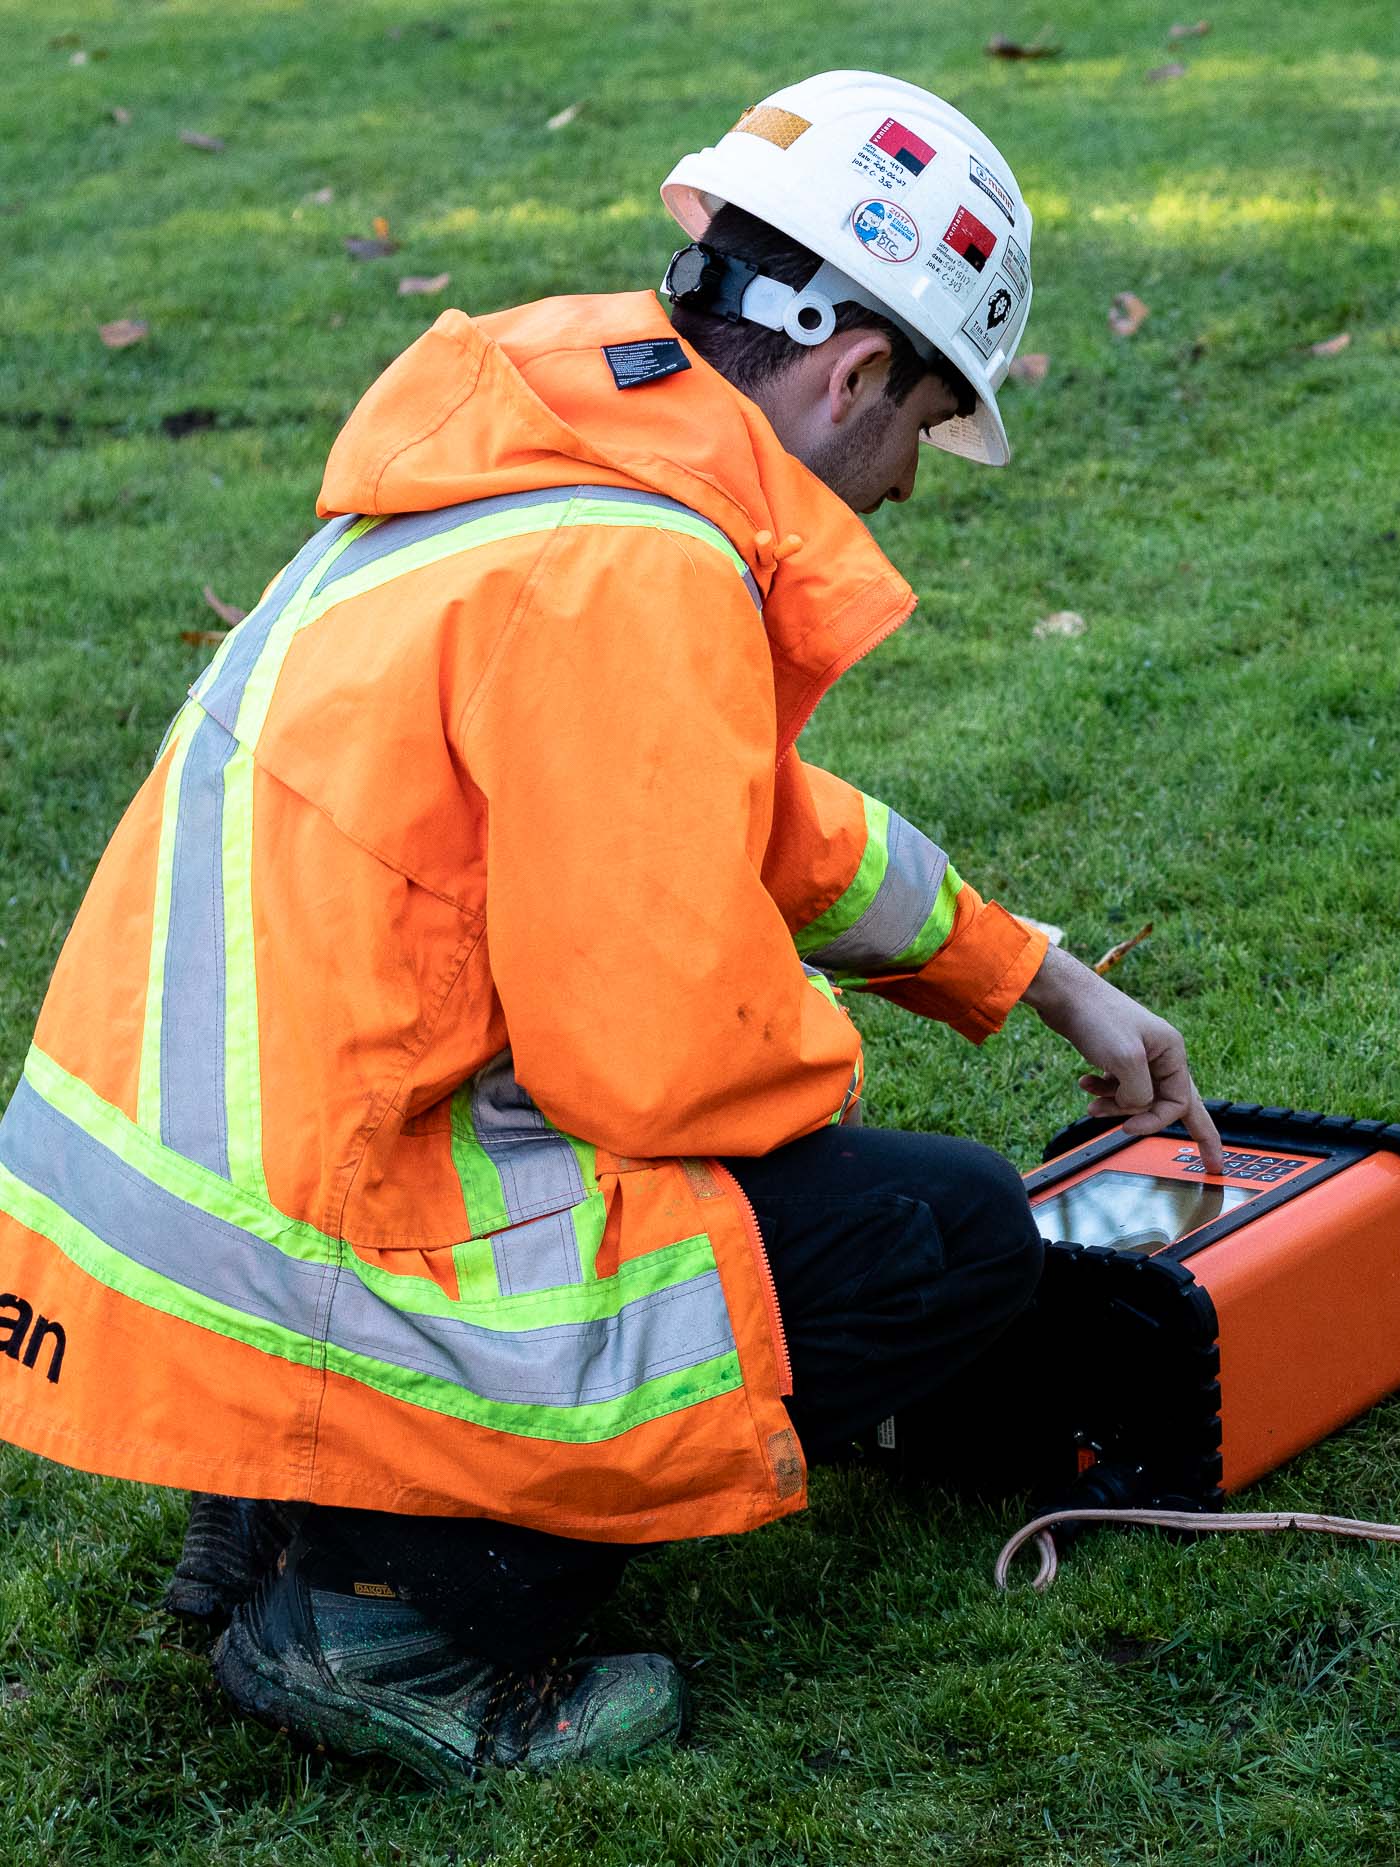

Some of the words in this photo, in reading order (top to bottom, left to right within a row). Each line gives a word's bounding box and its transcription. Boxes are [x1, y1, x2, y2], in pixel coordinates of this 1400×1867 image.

[873, 120, 895, 143] ventana
[852, 158, 863, 167] job
[889, 207, 910, 224] 2017
[945, 209, 965, 241] ventana
[892, 217, 915, 238] EllisDon
[877, 232, 899, 256] BTC
[926, 260, 936, 270] job
[358, 1585, 393, 1595] DAKOTA
